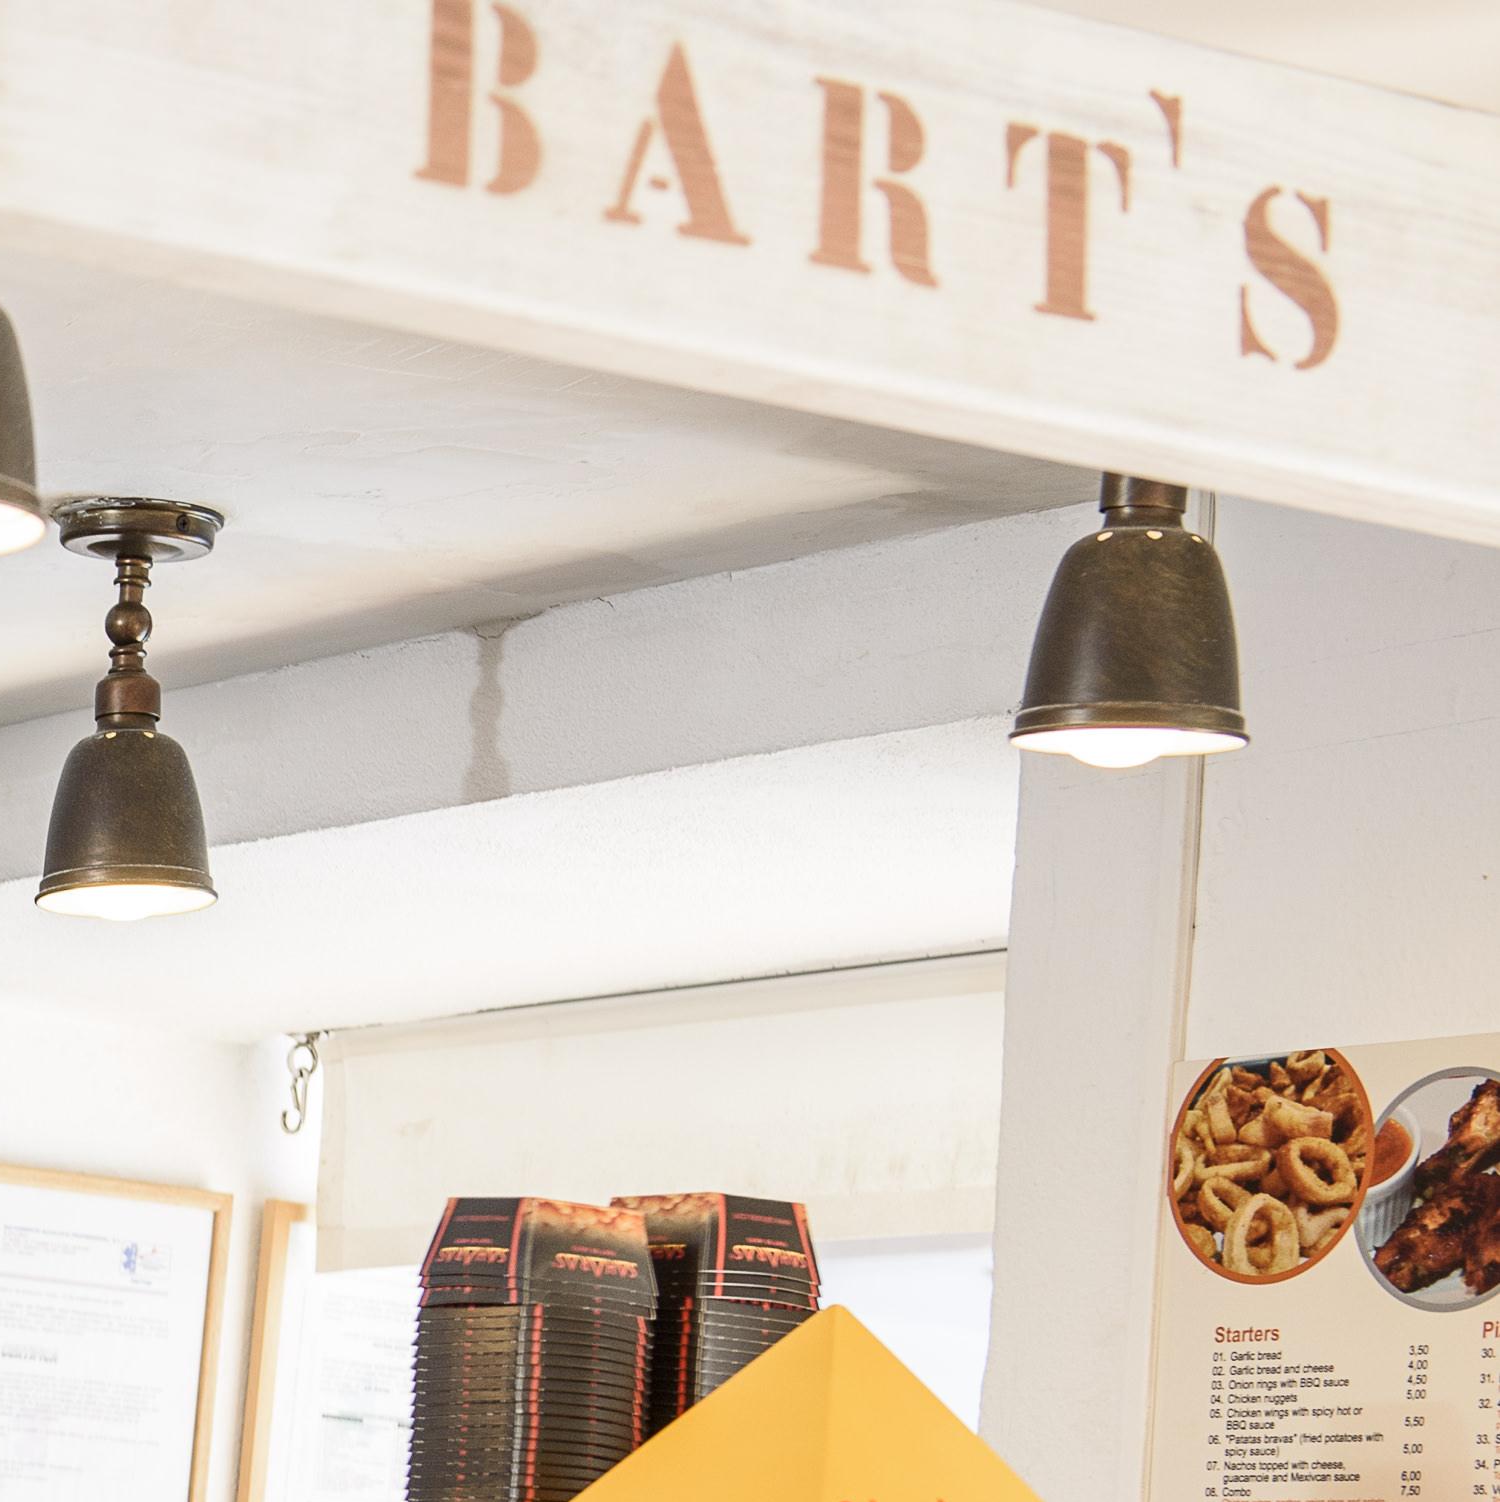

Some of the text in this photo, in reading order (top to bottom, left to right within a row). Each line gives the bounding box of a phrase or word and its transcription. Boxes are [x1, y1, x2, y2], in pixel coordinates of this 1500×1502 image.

[414, 0, 1342, 370] BART'S
[1214, 1326, 1281, 1343] Starters
[1230, 1351, 1256, 1362] Garlic
[1257, 1350, 1282, 1361] bread
[1409, 1345, 1430, 1356] 3,50
[1228, 1379, 1254, 1390] Onion
[1256, 1379, 1277, 1391] rings
[1300, 1377, 1320, 1388] BBQ
[1323, 1378, 1350, 1388] sauce
[1407, 1374, 1428, 1385] 4,50
[1227, 1393, 1262, 1404] Chicken
[1264, 1393, 1298, 1406] nuggets
[1406, 1389, 1427, 1400] 5,00
[1226, 1408, 1262, 1418] Chicken
[1264, 1407, 1289, 1419] wings
[1312, 1406, 1335, 1419] spicy
[1336, 1406, 1352, 1416] hot
[1353, 1407, 1364, 1416] or
[1226, 1416, 1425, 1430] BBQ sauce 5,50
[1223, 1461, 1257, 1471] Nachos
[1259, 1460, 1289, 1472] topped
[1271, 1473, 1288, 1483] and
[1333, 1472, 1361, 1482] sauce
[1401, 1470, 1422, 1482] 6,00
[1222, 1487, 1252, 1497] Combo
[1400, 1485, 1421, 1497] 7,50
